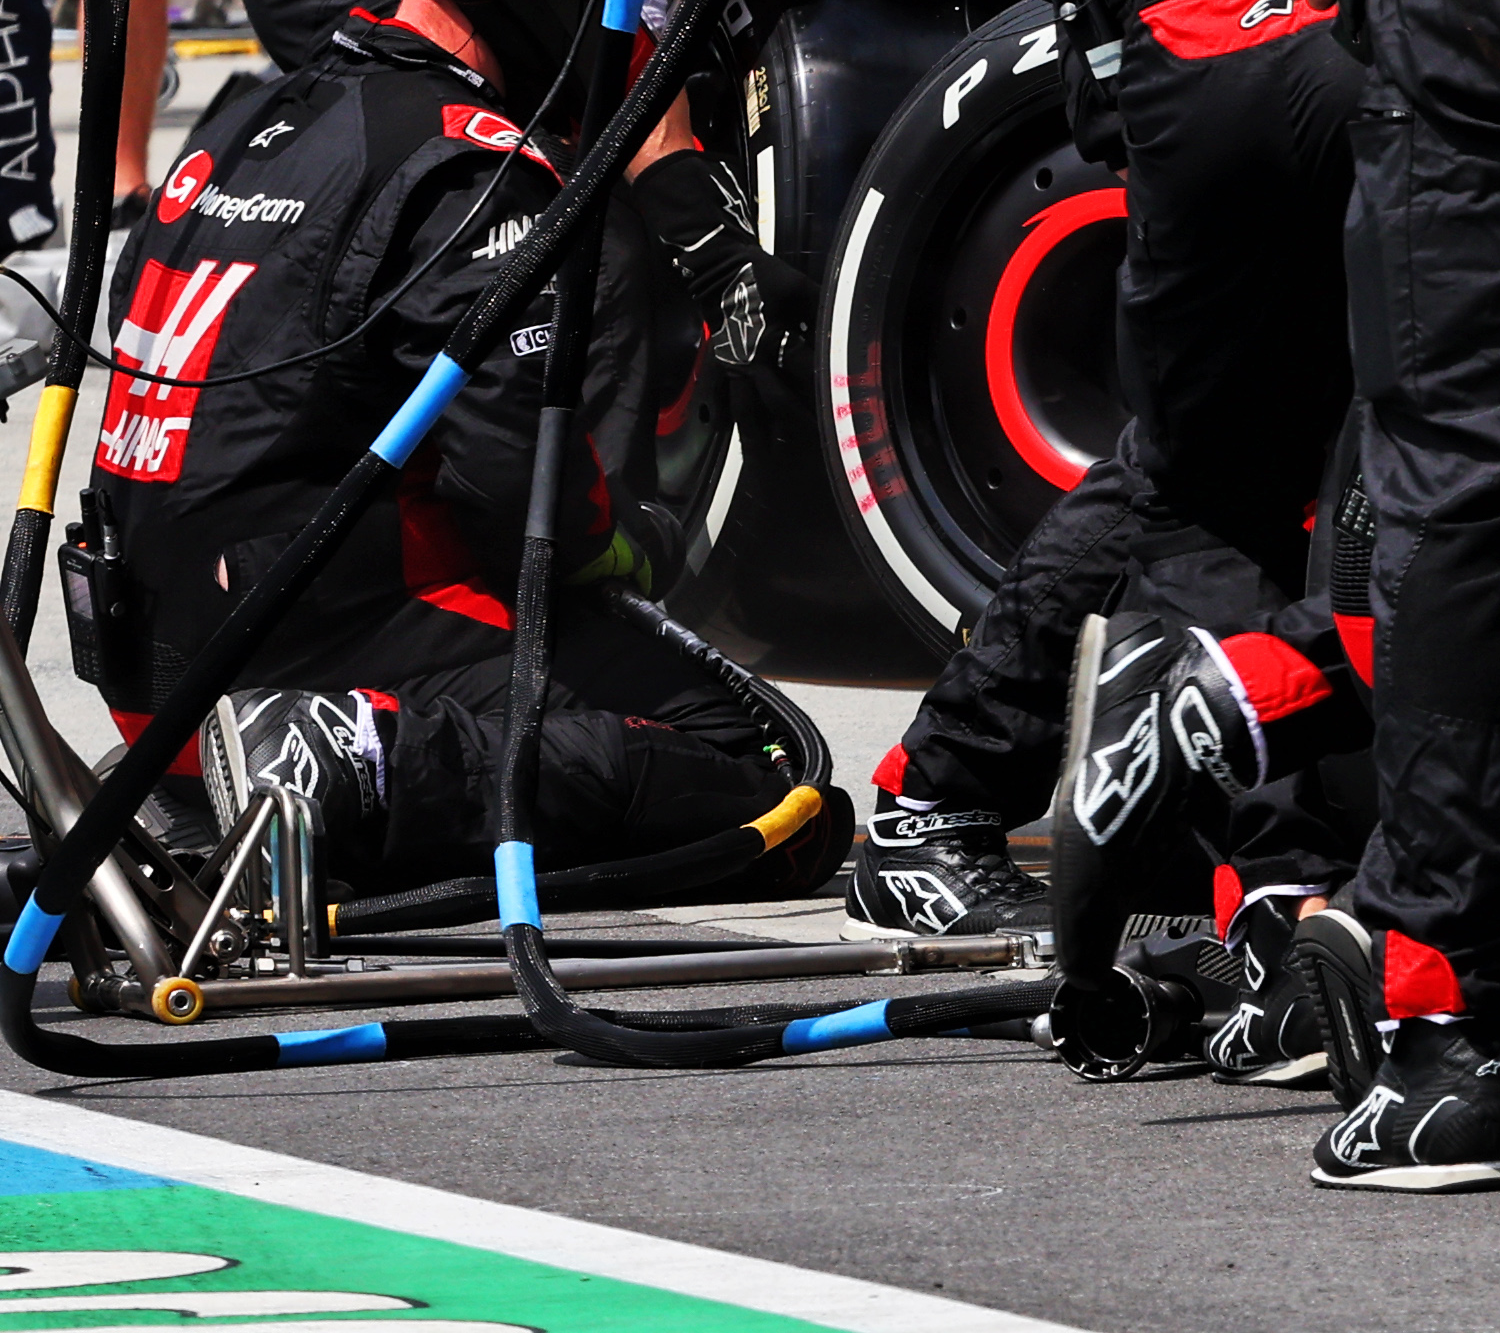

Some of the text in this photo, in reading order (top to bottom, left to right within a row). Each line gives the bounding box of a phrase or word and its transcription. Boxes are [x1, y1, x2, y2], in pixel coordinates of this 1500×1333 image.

[191, 183, 306, 227] MoneyGram
[102, 412, 190, 474] HAAS
[896, 809, 1002, 837] alpinestars
